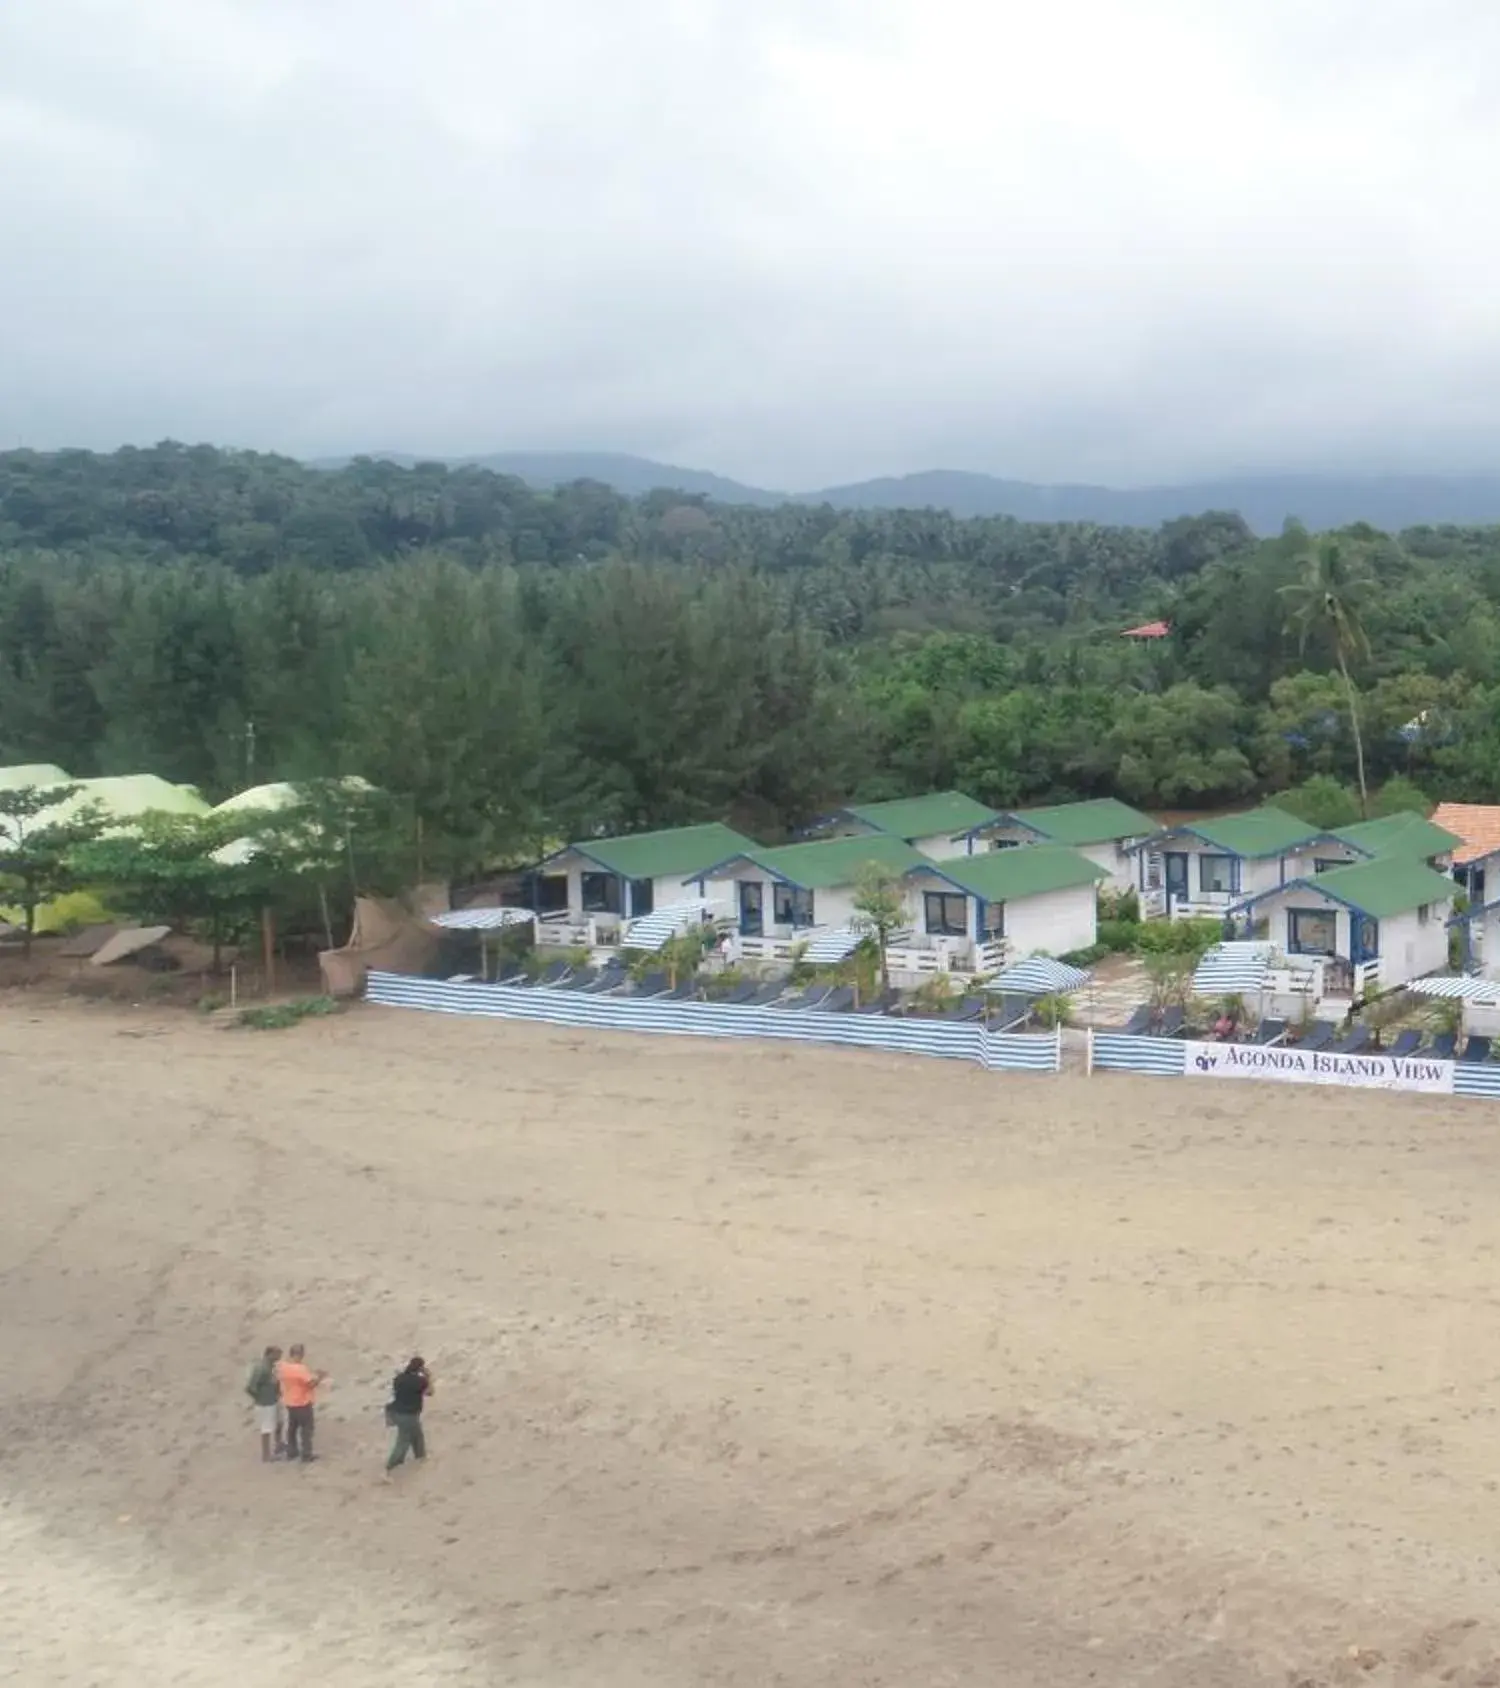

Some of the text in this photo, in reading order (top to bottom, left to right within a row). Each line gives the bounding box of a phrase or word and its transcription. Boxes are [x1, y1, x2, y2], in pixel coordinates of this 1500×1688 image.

[1224, 1046, 1445, 1081] AGONDA ISLAND VIEW
